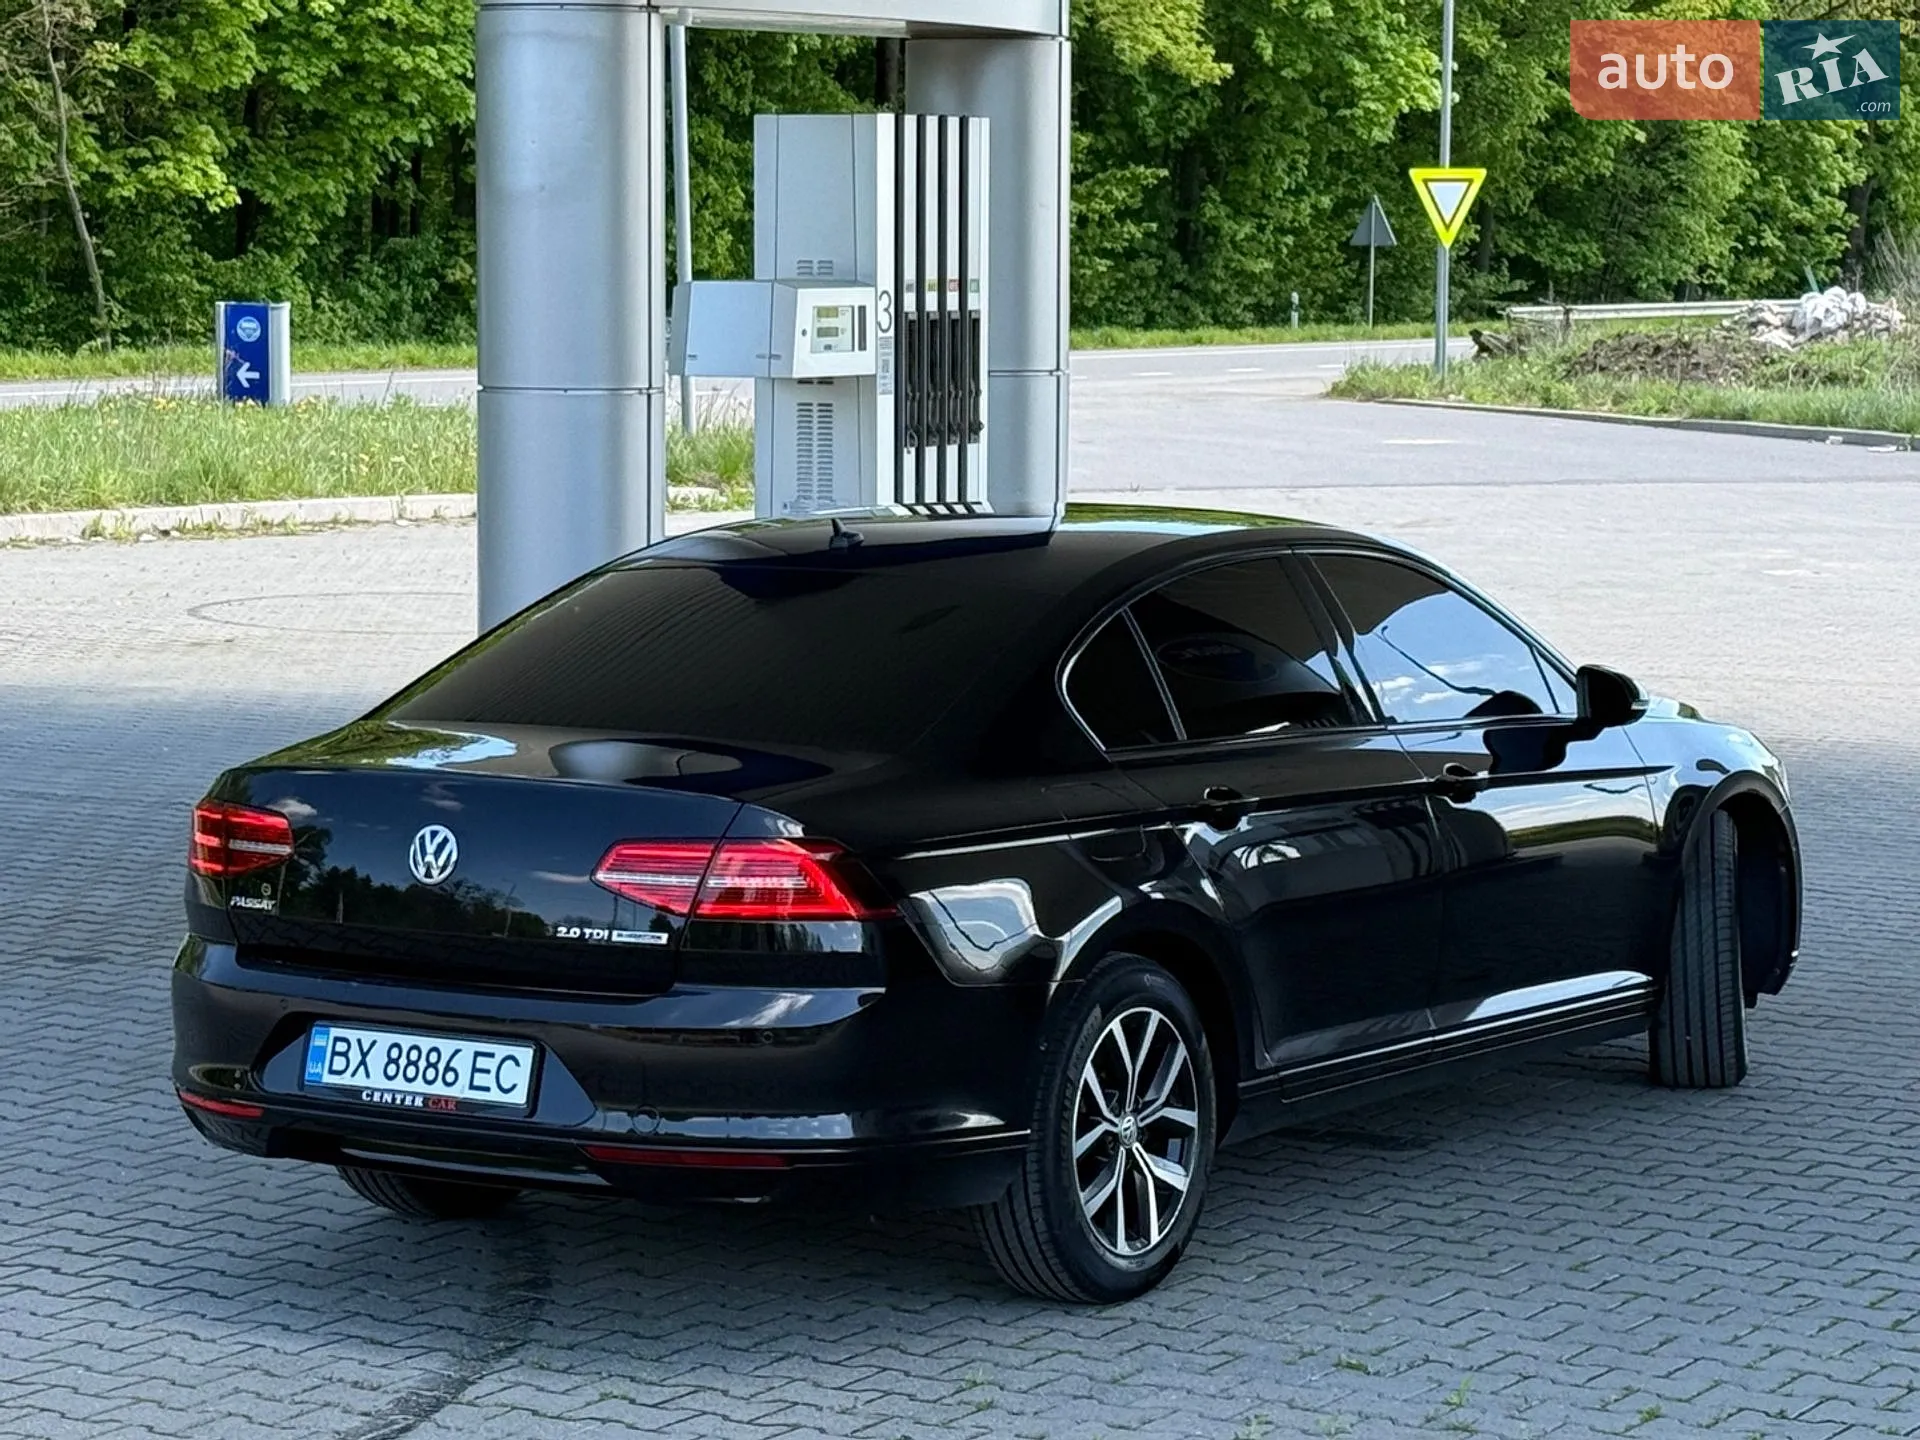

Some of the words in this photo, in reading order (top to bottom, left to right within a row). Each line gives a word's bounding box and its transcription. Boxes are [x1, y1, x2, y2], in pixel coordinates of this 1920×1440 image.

[876, 290, 893, 334] 3
[230, 895, 277, 911] PASSAT
[556, 926, 581, 939] 2.0
[583, 927, 610, 941] TDI
[327, 1035, 378, 1080] BX
[382, 1041, 463, 1088] 8886
[467, 1050, 521, 1094] EC
[361, 1089, 424, 1108] CENTER
[427, 1095, 457, 1111] CAR
